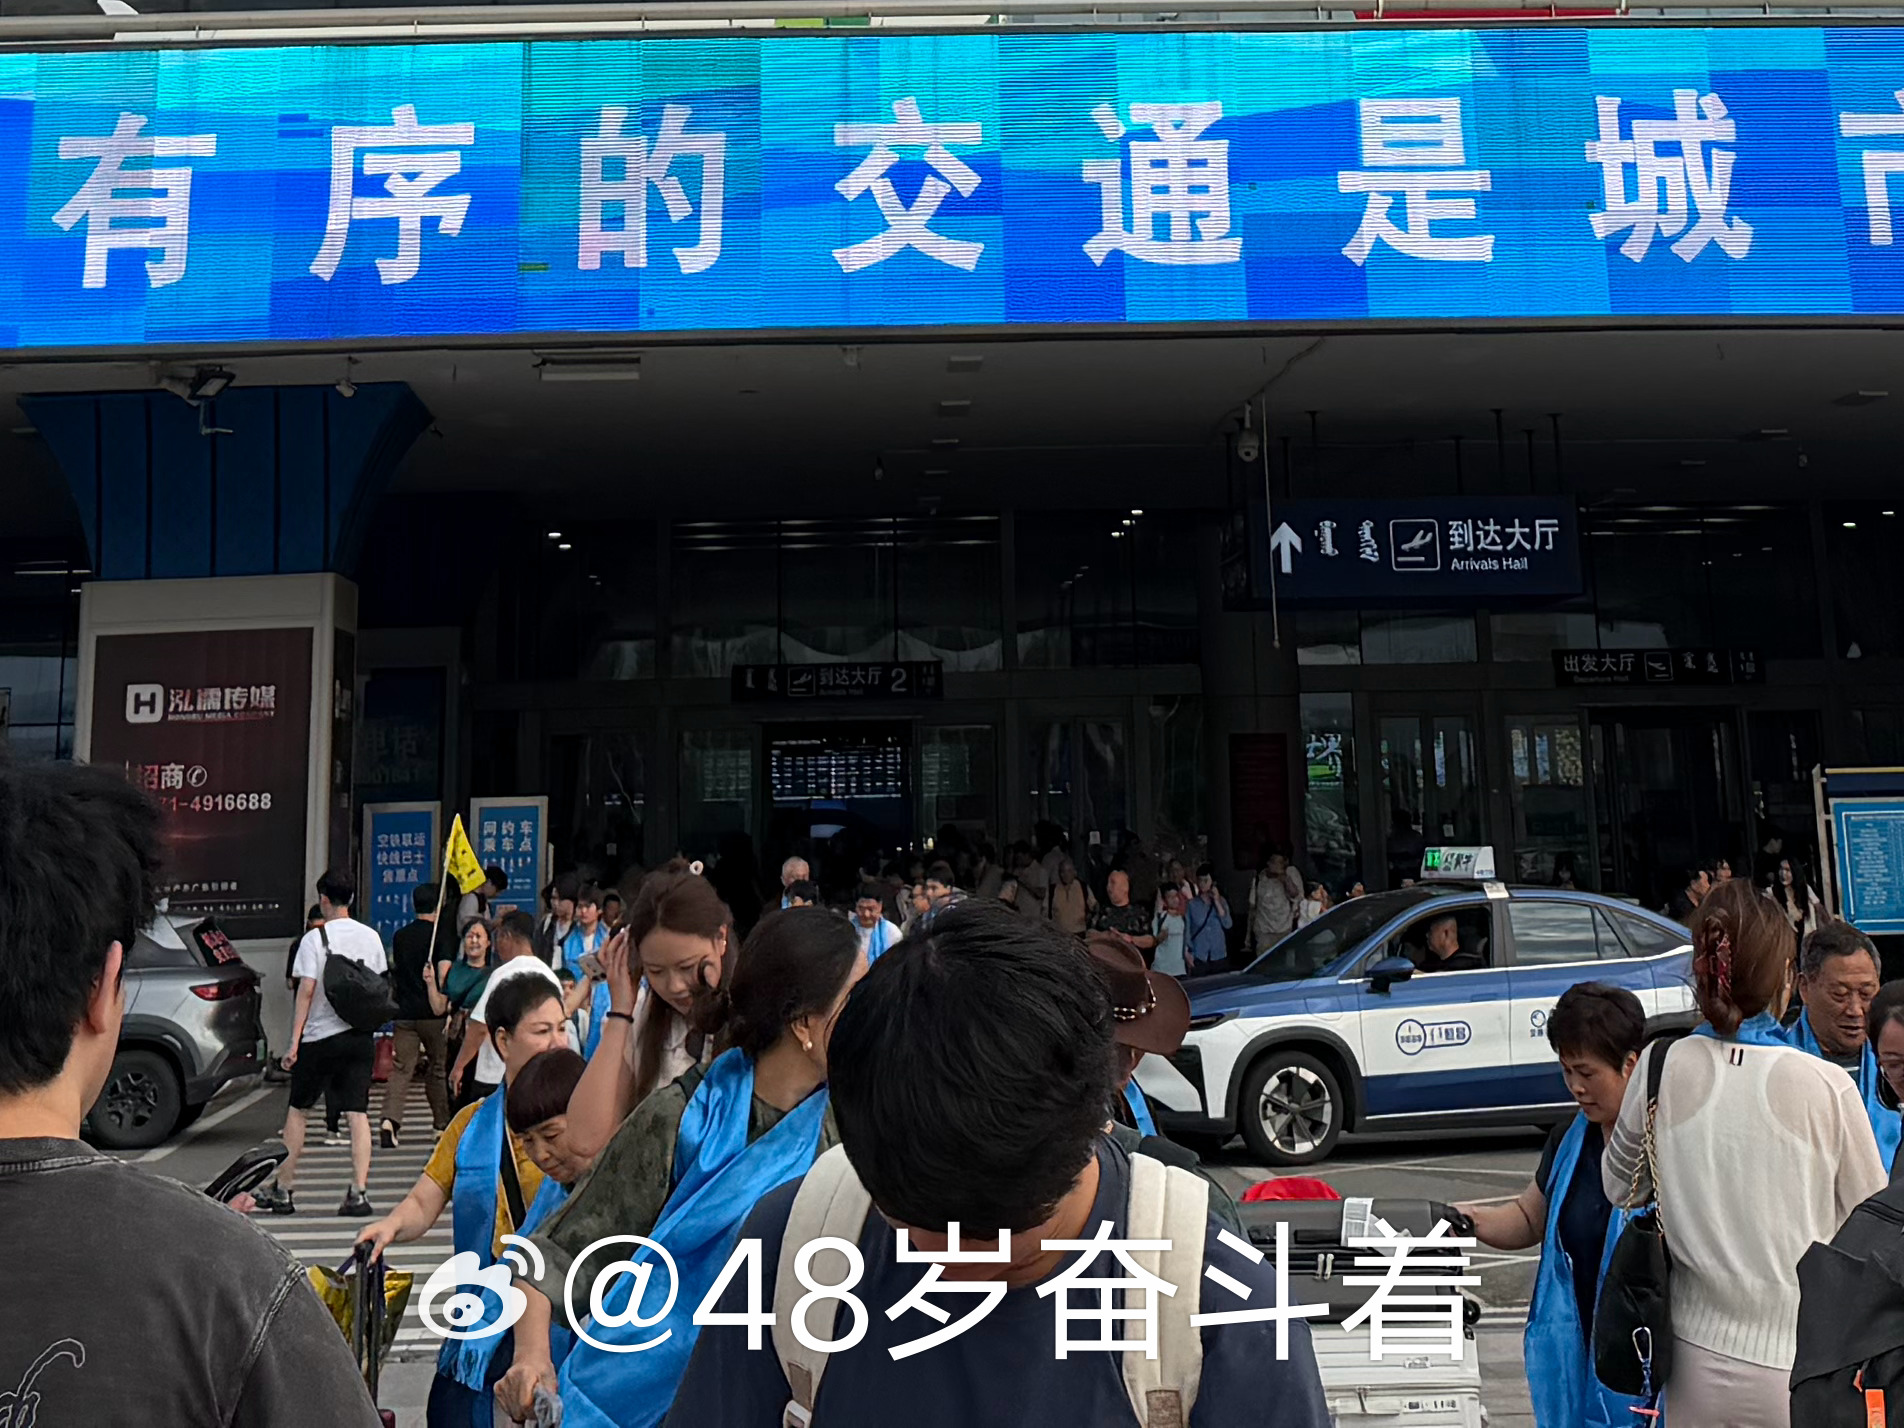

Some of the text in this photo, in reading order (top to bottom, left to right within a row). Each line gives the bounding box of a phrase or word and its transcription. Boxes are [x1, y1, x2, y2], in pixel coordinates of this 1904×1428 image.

[1448, 518, 1561, 553] 到达大厅
[1450, 556, 1529, 572] Arrivals Hall
[1562, 652, 1636, 673] 出发大厅
[819, 665, 883, 687] 到达大厅
[890, 667, 909, 693] 2
[483, 820, 534, 837] 网约车
[483, 837, 533, 852] 乘车点
